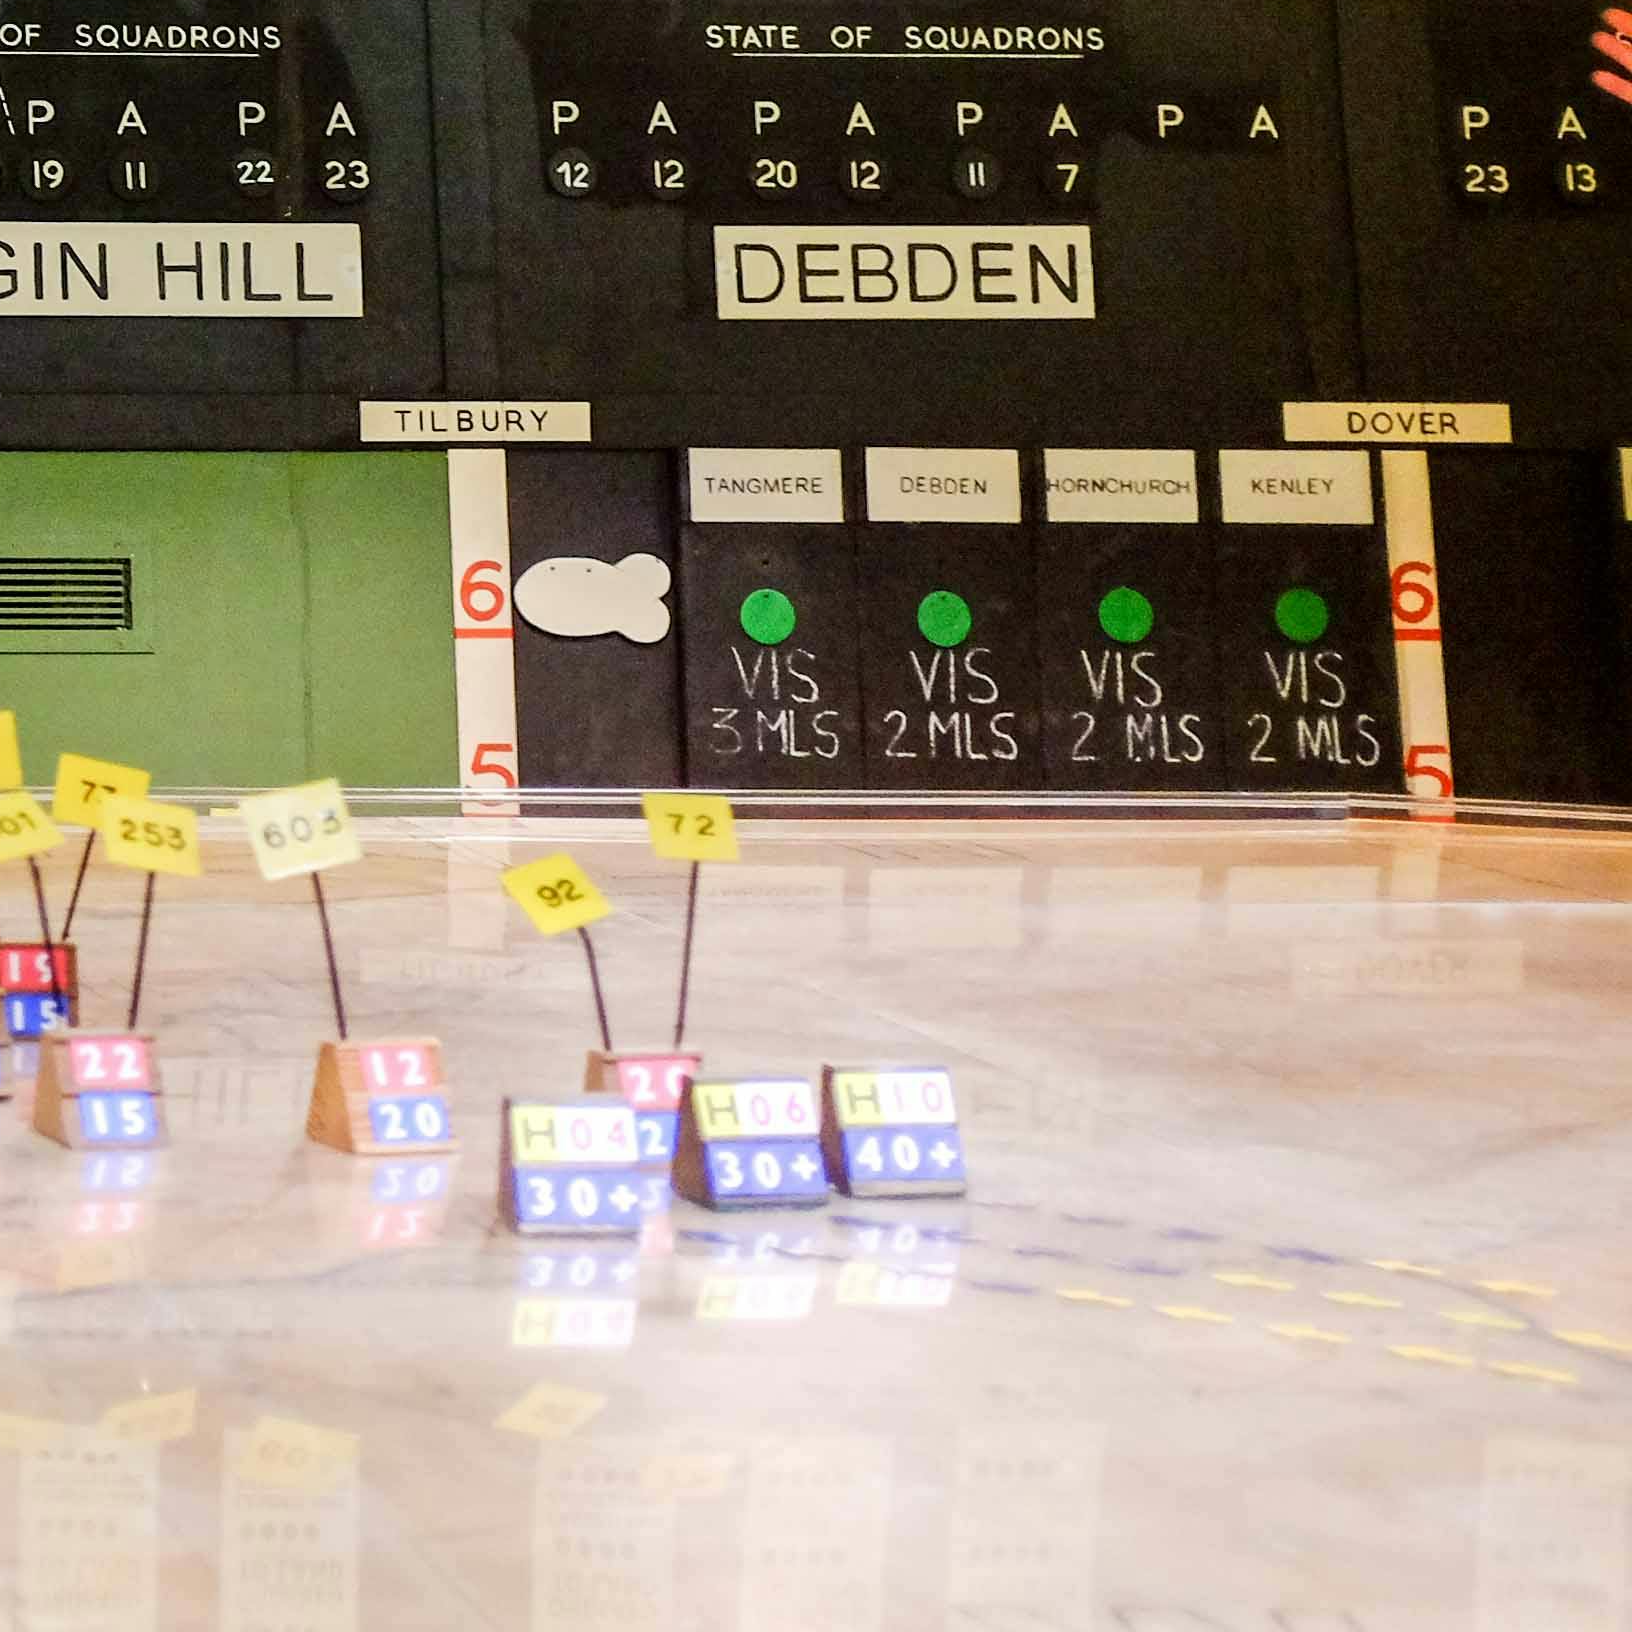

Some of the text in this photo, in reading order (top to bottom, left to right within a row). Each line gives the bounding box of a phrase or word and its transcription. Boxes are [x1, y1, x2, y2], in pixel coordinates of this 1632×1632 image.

[0, 24, 40, 46] OF
[76, 24, 280, 48] SQUADRONS
[706, 25, 1104, 50] STATE OF SQUADRONS
[239, 102, 355, 136] P A
[1158, 105, 1278, 138] P A
[237, 161, 369, 188] 22 23
[757, 159, 1078, 192] 20 7
[157, 242, 333, 301] HILL
[734, 242, 1078, 304] DEBDEN
[394, 410, 547, 432] TILBURY
[1347, 412, 1459, 435] DOVER
[705, 477, 822, 494] TANGMERE
[901, 476, 986, 494] DEBDEN
[1041, 472, 1190, 500] HORNCHURCH
[1251, 478, 1332, 495] KENLEY
[910, 650, 998, 704] VIS
[1081, 650, 1162, 707] VIS
[1265, 652, 1345, 708] VIS
[884, 710, 1018, 760] 2 MLS
[1072, 711, 1204, 762] 2 MLS
[1248, 714, 1276, 762] 2
[121, 819, 186, 851] 253
[667, 813, 714, 836] 72
[537, 879, 583, 907] 92
[79, 1045, 140, 1080] 22
[371, 1051, 425, 1086] 12
[93, 1100, 145, 1135] 15
[380, 1103, 441, 1140] 20
